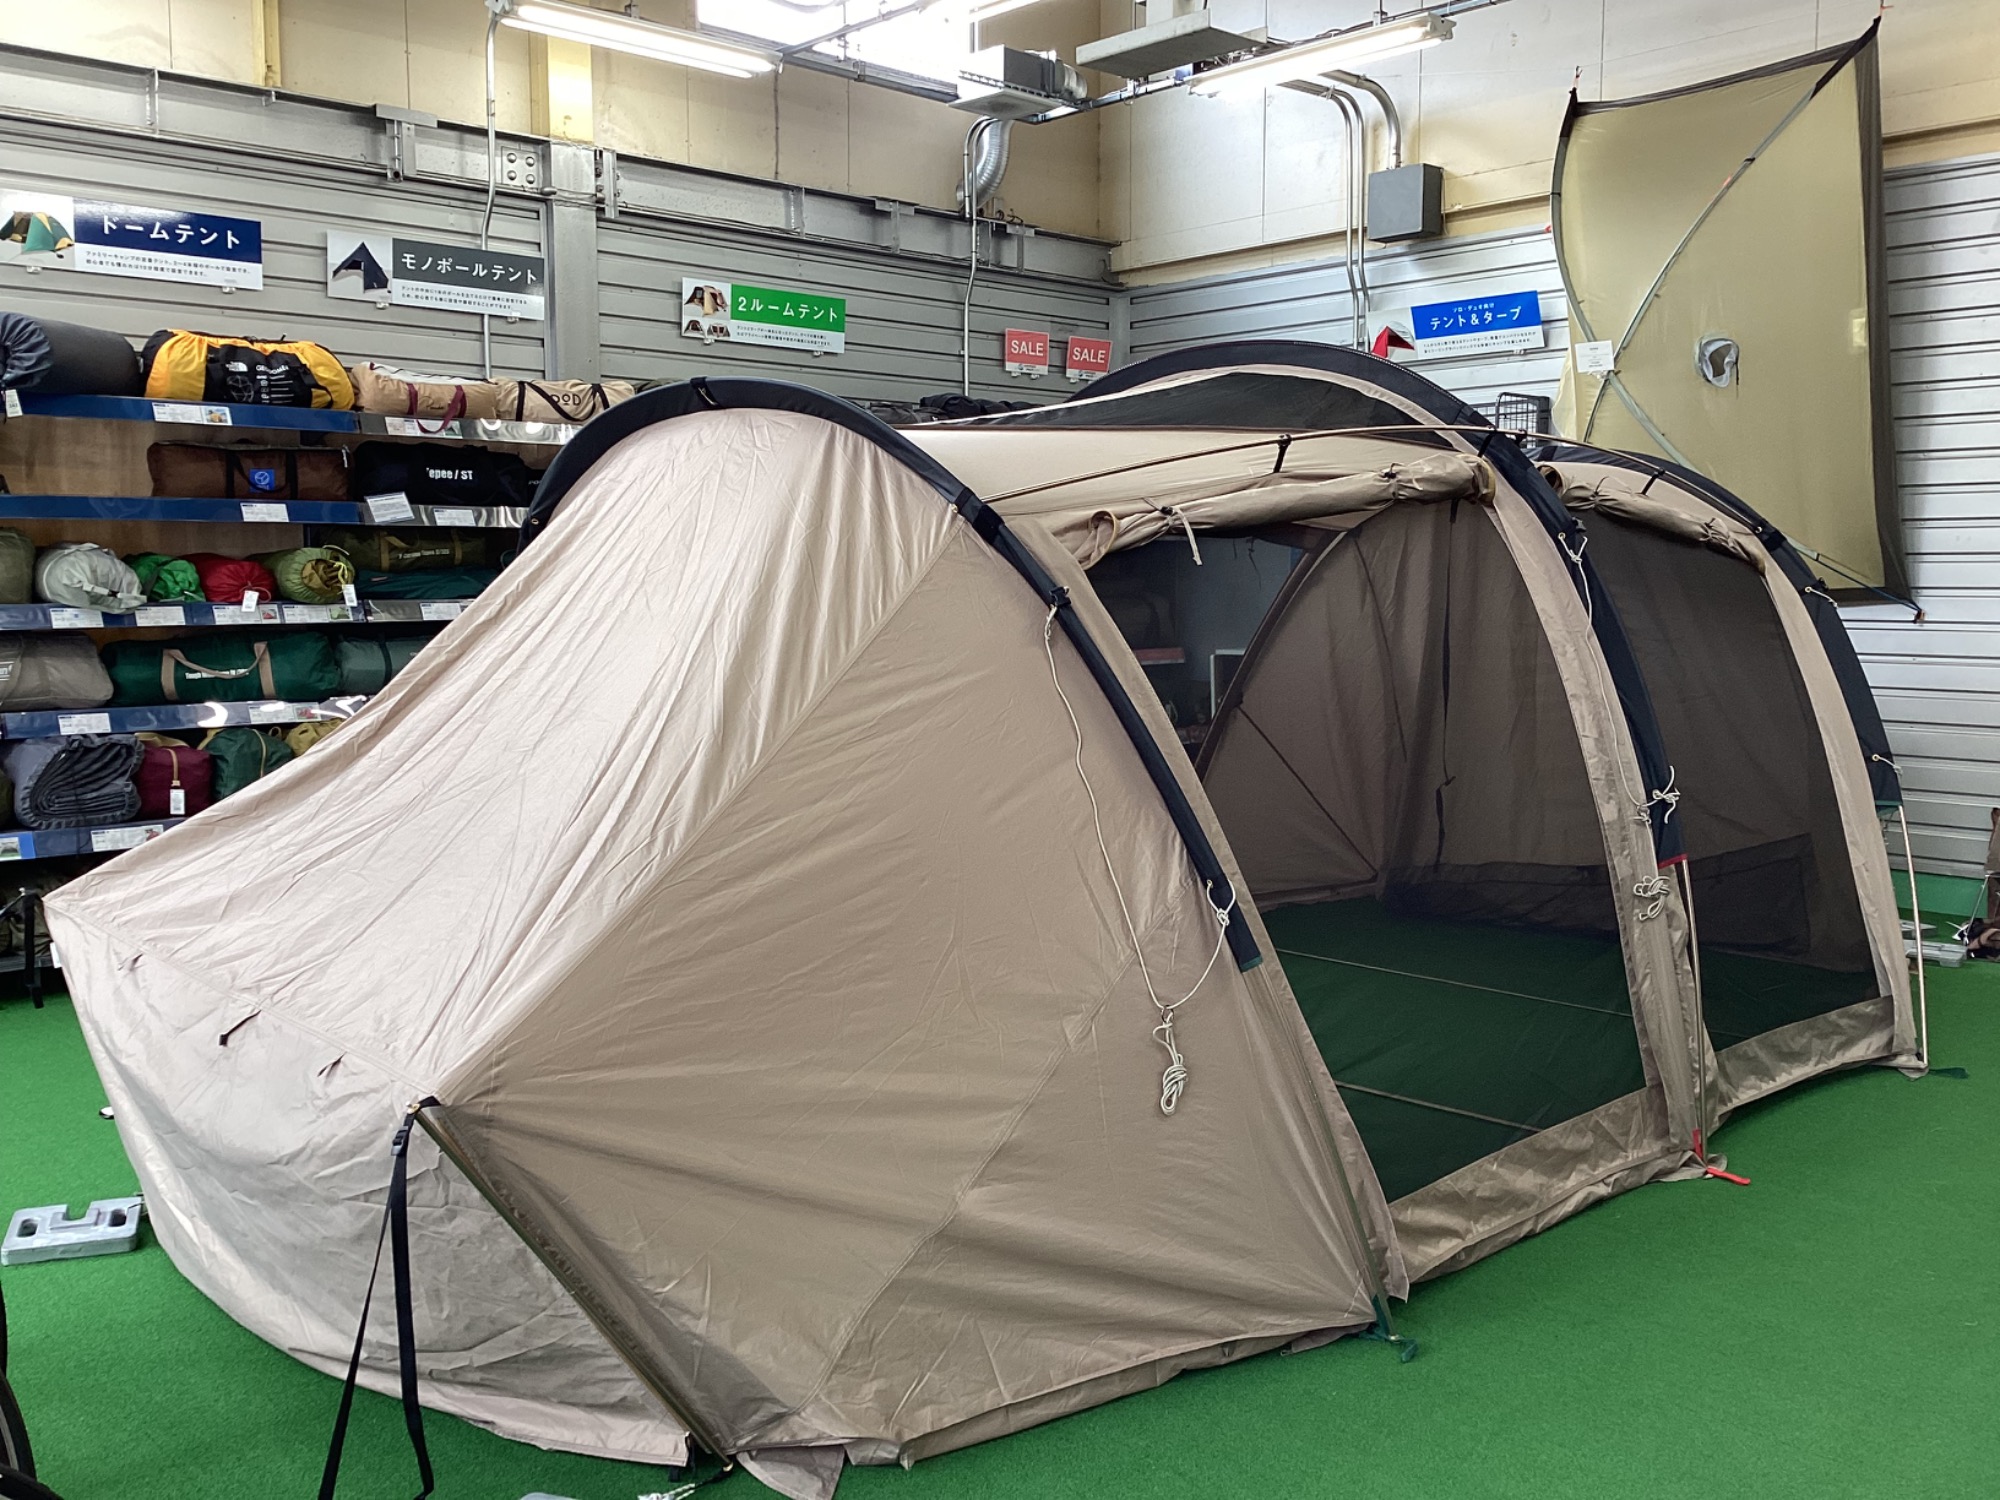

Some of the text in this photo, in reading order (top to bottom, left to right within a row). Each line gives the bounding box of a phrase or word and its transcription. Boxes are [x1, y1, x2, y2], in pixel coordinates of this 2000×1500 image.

[102, 214, 240, 250] ドームテント
[401, 253, 537, 285] モノポールテント
[737, 296, 839, 323] 2ルームテント
[1430, 305, 1522, 331] テント&タープ
[1011, 339, 1044, 356] SALE
[1072, 347, 1107, 363] SALE
[460, 470, 473, 480] ST
